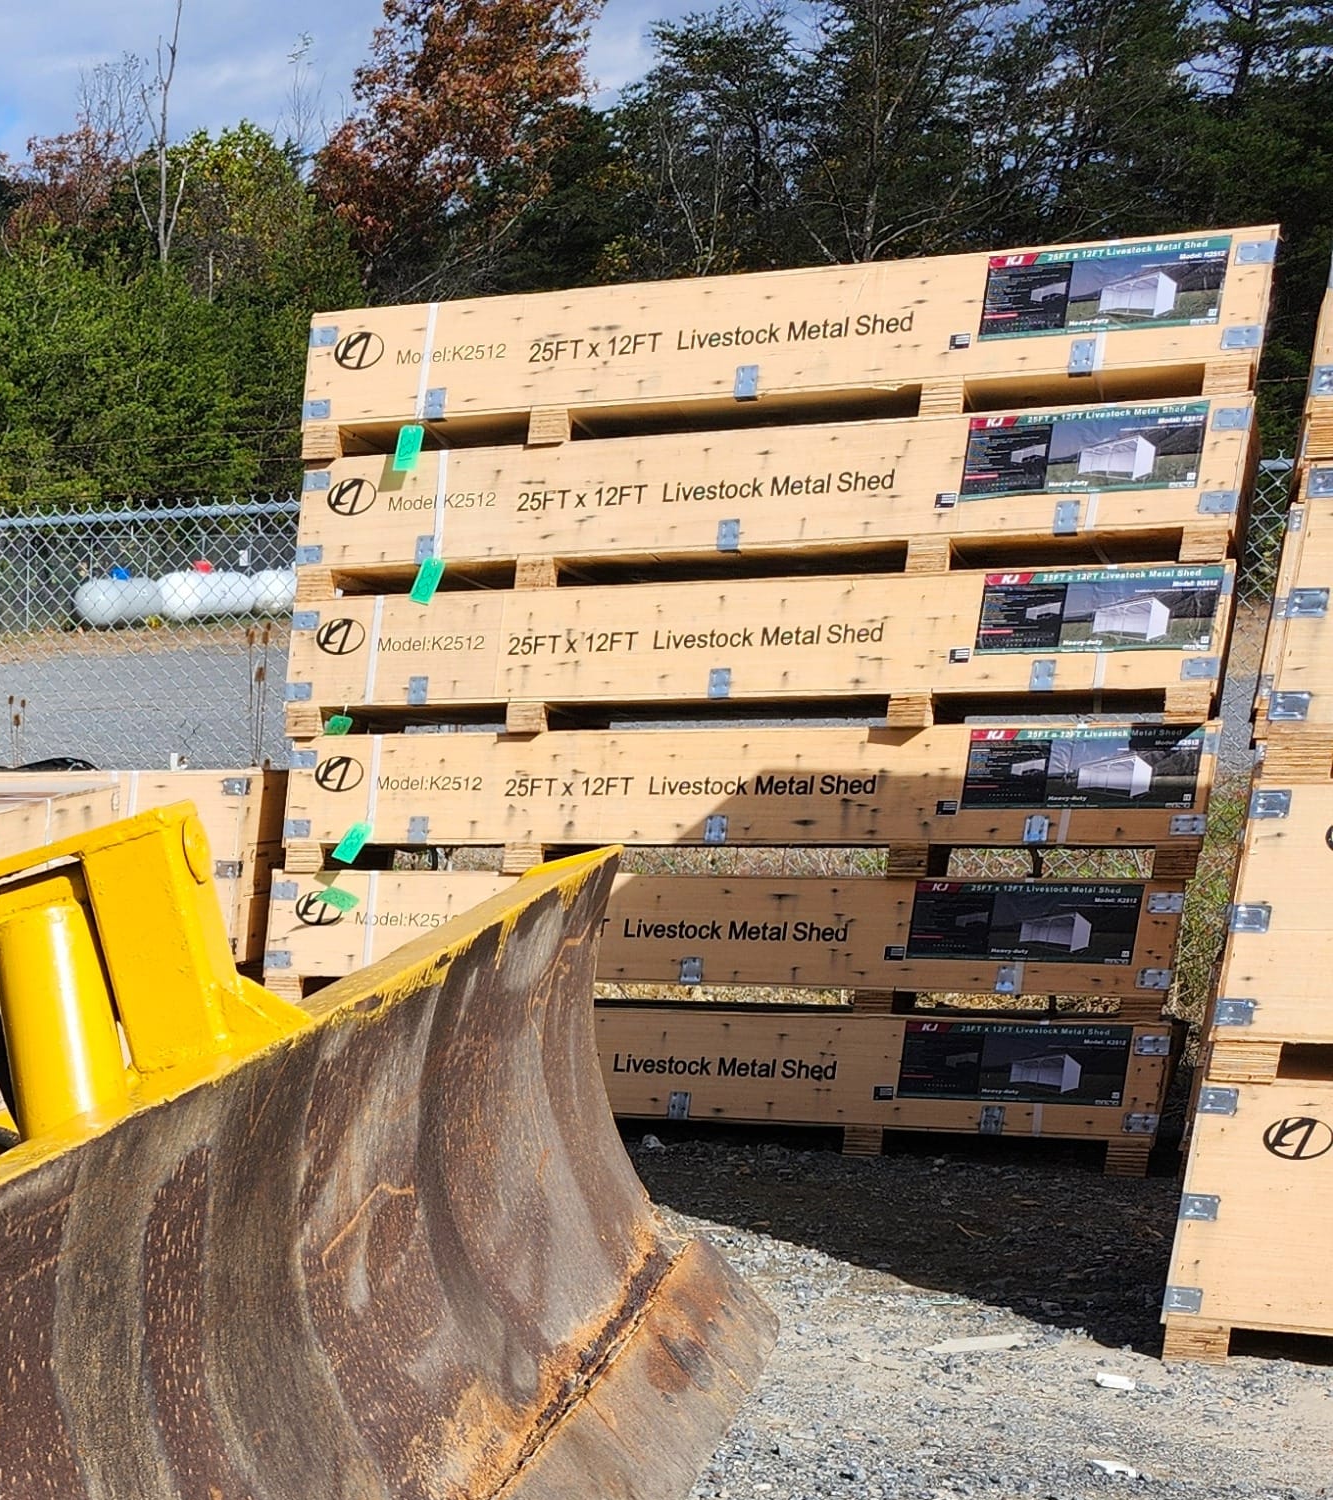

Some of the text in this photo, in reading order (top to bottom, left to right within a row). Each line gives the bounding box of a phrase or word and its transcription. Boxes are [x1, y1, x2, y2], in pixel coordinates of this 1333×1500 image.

[1005, 255, 1025, 266] KJ
[528, 311, 914, 362] 25FT x 12FT Livestock Metal Shed
[985, 417, 1004, 427] KJ
[517, 468, 895, 512] 25FT x 12FT Livestock Metal Shed
[1001, 575, 1020, 585] KJ
[377, 635, 485, 652] Model:K2512
[508, 622, 884, 655] 25FT x 12FT Livestock Metal Shed
[986, 730, 1004, 740] KJ
[377, 776, 482, 791] Model:K2512
[504, 774, 877, 797] 25FT x 12FT Livestock Metal Shed
[932, 883, 949, 892] KJ
[971, 884, 993, 892] 25FT
[1003, 885, 1024, 893] 12FT
[1026, 885, 1069, 894] Livestock
[1071, 886, 1096, 894] Metal
[1098, 886, 1121, 894] Shed
[623, 918, 722, 940] Livestock
[728, 921, 788, 942] Metal
[792, 922, 849, 942] Shed
[921, 1023, 938, 1032] KJ
[960, 1025, 982, 1033] 25FT
[992, 1026, 1014, 1034] 12FT
[1015, 1027, 1058, 1035] Livestock
[1060, 1028, 1085, 1036] Metal
[1087, 1028, 1110, 1036] Shed
[613, 1053, 837, 1080] Livestock Metal Shed
